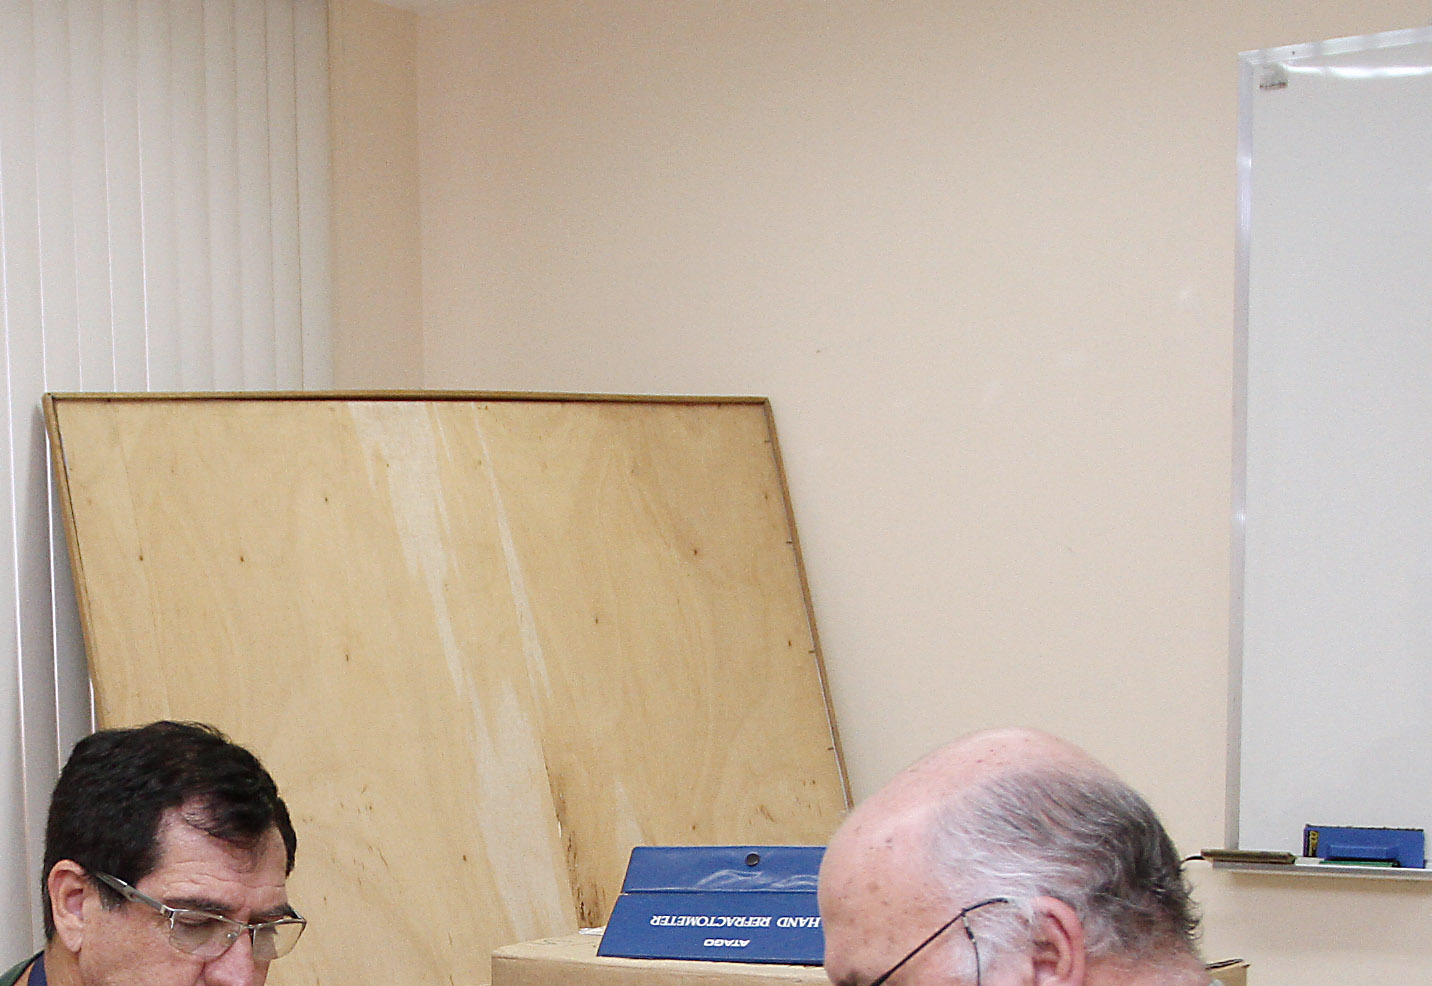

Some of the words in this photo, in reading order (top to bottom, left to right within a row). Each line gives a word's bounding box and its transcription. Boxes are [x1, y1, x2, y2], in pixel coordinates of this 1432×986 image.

[650, 915, 772, 928] REFRACTOMETER
[776, 916, 821, 928] HAND
[703, 938, 751, 947] ATAGO
